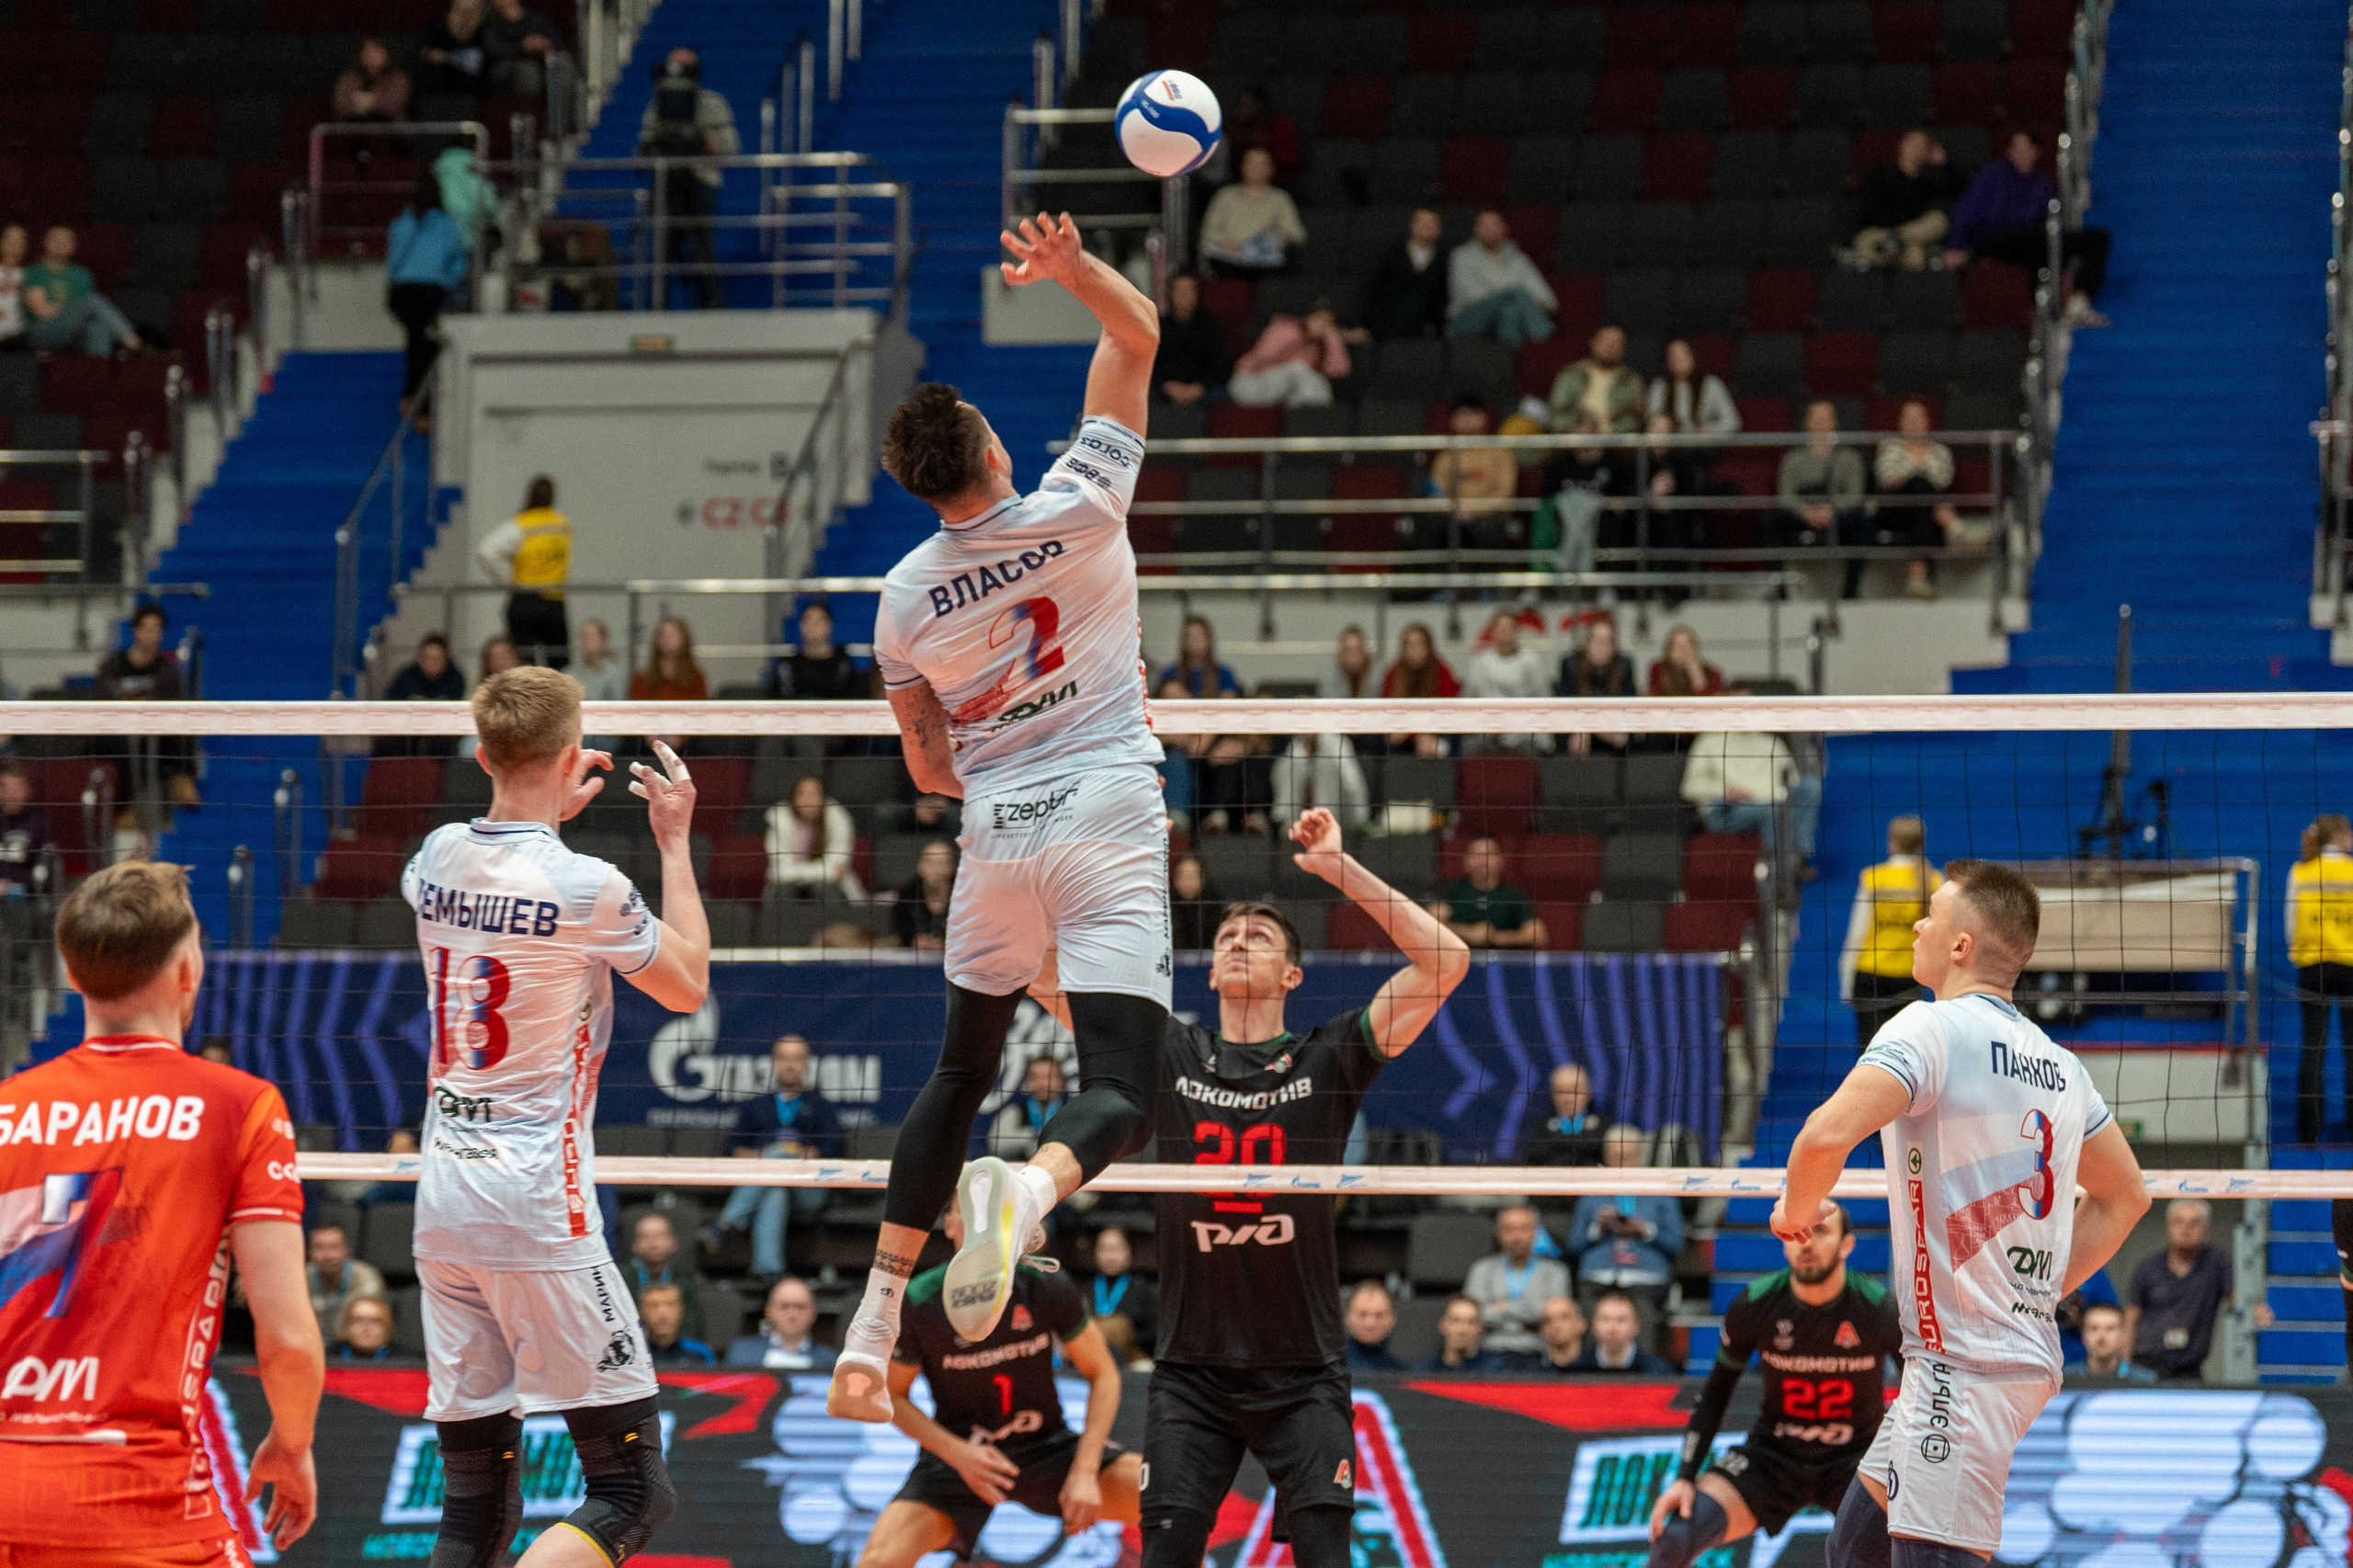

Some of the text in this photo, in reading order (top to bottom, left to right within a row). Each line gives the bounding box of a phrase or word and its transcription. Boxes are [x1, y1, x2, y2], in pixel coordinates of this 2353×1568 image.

[988, 596, 1065, 696] 2
[418, 878, 560, 937] ЕМЫШЕВ
[428, 946, 511, 1071] 18
[1175, 1075, 1313, 1110] ЛОКОМОТИВ
[1990, 1040, 2066, 1093] ПАНКОВ
[1194, 1120, 1286, 1199] 20
[2018, 1108, 2055, 1221] 3
[42, 1166, 125, 1319] 7
[993, 1373, 1014, 1416] 1
[1781, 1376, 1855, 1420] 22
[1930, 1362, 1951, 1428] ЭЛЬГА
